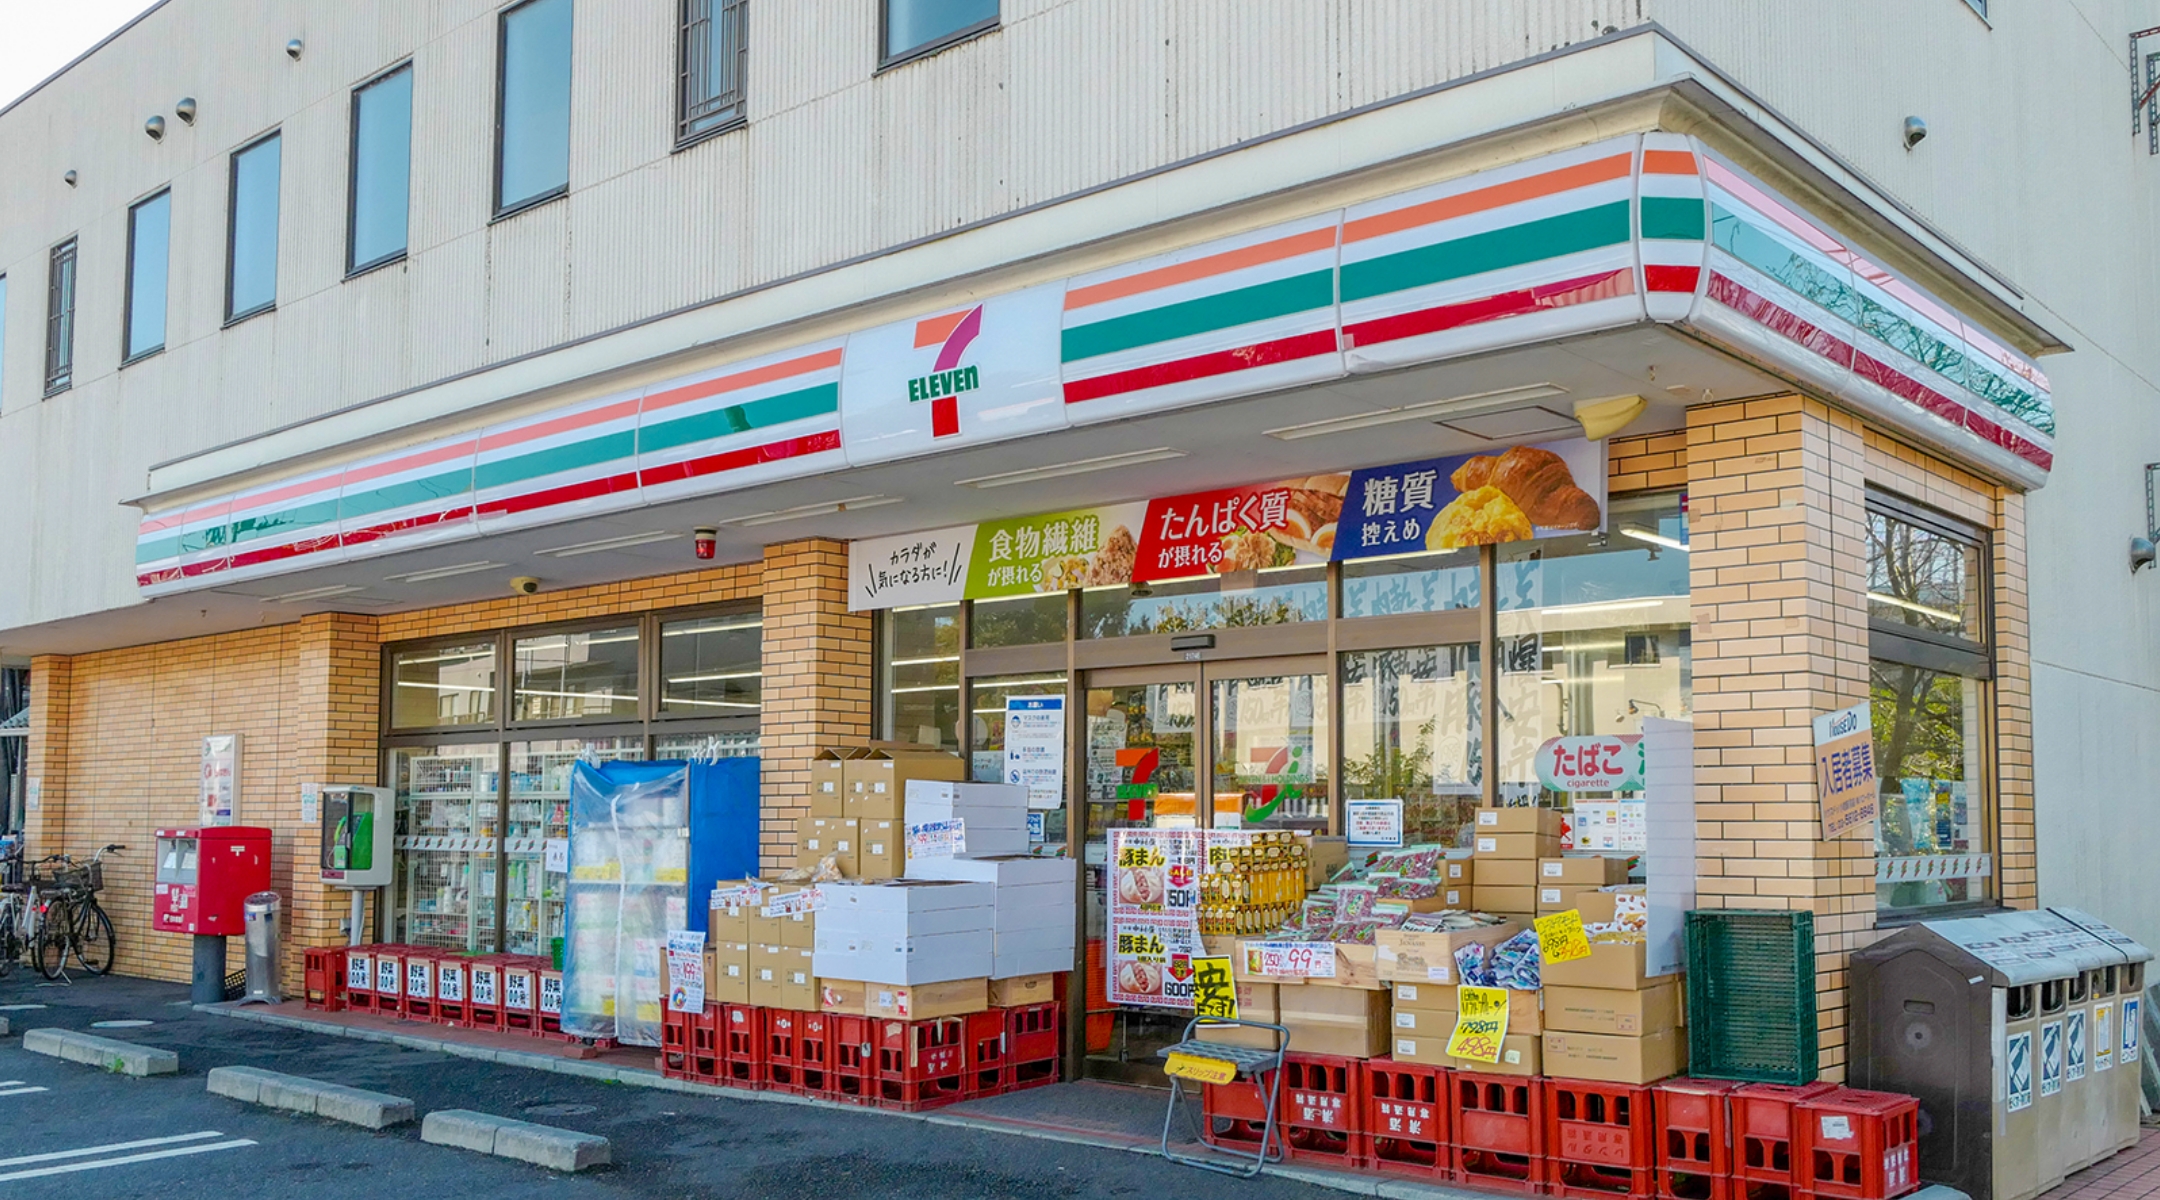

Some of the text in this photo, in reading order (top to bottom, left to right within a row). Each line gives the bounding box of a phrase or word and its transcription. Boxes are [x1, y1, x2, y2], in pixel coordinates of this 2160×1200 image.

[1362, 469, 1438, 517] 糖質
[1160, 490, 1290, 541] たんぱく質
[988, 515, 1099, 563] 食物繊維
[1361, 518, 1421, 547] 控えめ
[889, 541, 938, 566] カラダが
[1158, 542, 1224, 569] が摂れる
[987, 563, 1044, 587] が摂れる
[1553, 742, 1624, 778] たばこ
[1821, 741, 1874, 799] 入居者募集
[1566, 779, 1610, 789] cigarette
[1118, 847, 1166, 867] 豚まん
[1118, 934, 1165, 955] 豚まん
[1186, 1066, 1227, 1080] スリップ注意
[1389, 1117, 1422, 1134] 清酒
[1567, 1142, 1625, 1158] レンタル
